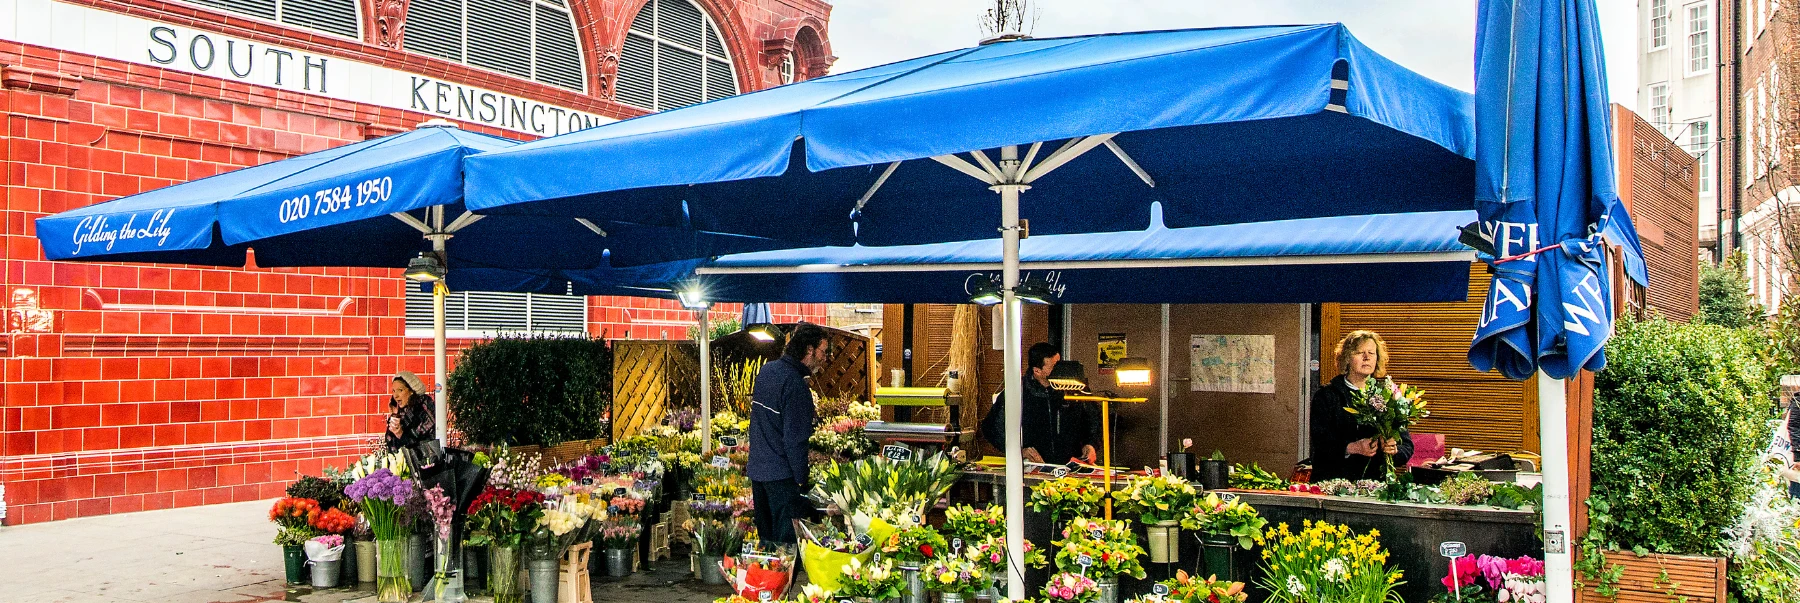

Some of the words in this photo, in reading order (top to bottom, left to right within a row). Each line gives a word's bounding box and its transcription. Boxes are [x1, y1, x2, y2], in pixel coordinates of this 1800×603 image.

[148, 26, 328, 93] SOUTH
[279, 194, 311, 224] 020
[314, 184, 353, 216] 7584
[355, 176, 393, 207] 1950
[72, 214, 118, 256] Gilding
[119, 213, 137, 240] the
[137, 207, 176, 247] Lily
